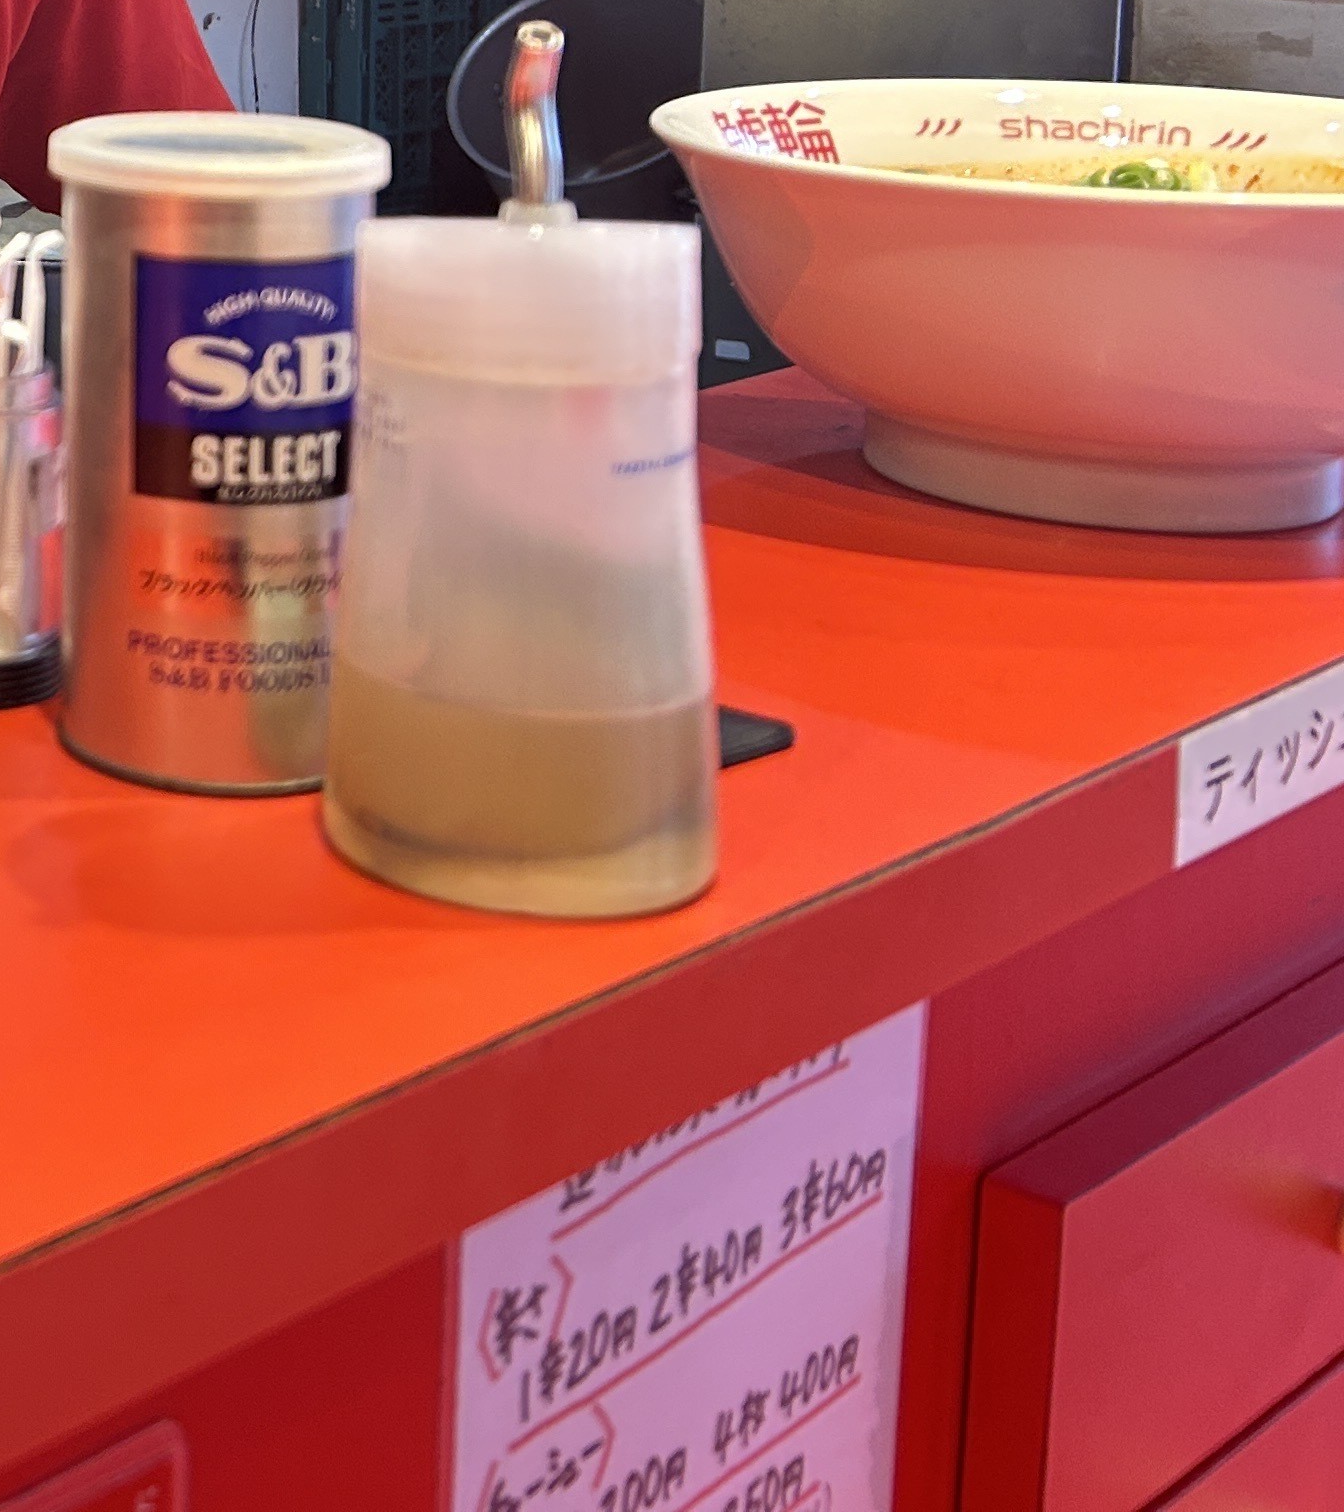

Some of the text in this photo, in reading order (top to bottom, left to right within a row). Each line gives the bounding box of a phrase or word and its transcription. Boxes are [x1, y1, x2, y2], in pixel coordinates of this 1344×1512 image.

[999, 114, 1192, 148] shachirin
[166, 331, 358, 412] S&B
[189, 429, 342, 488] SELECT
[1205, 710, 1344, 823] ティッシ
